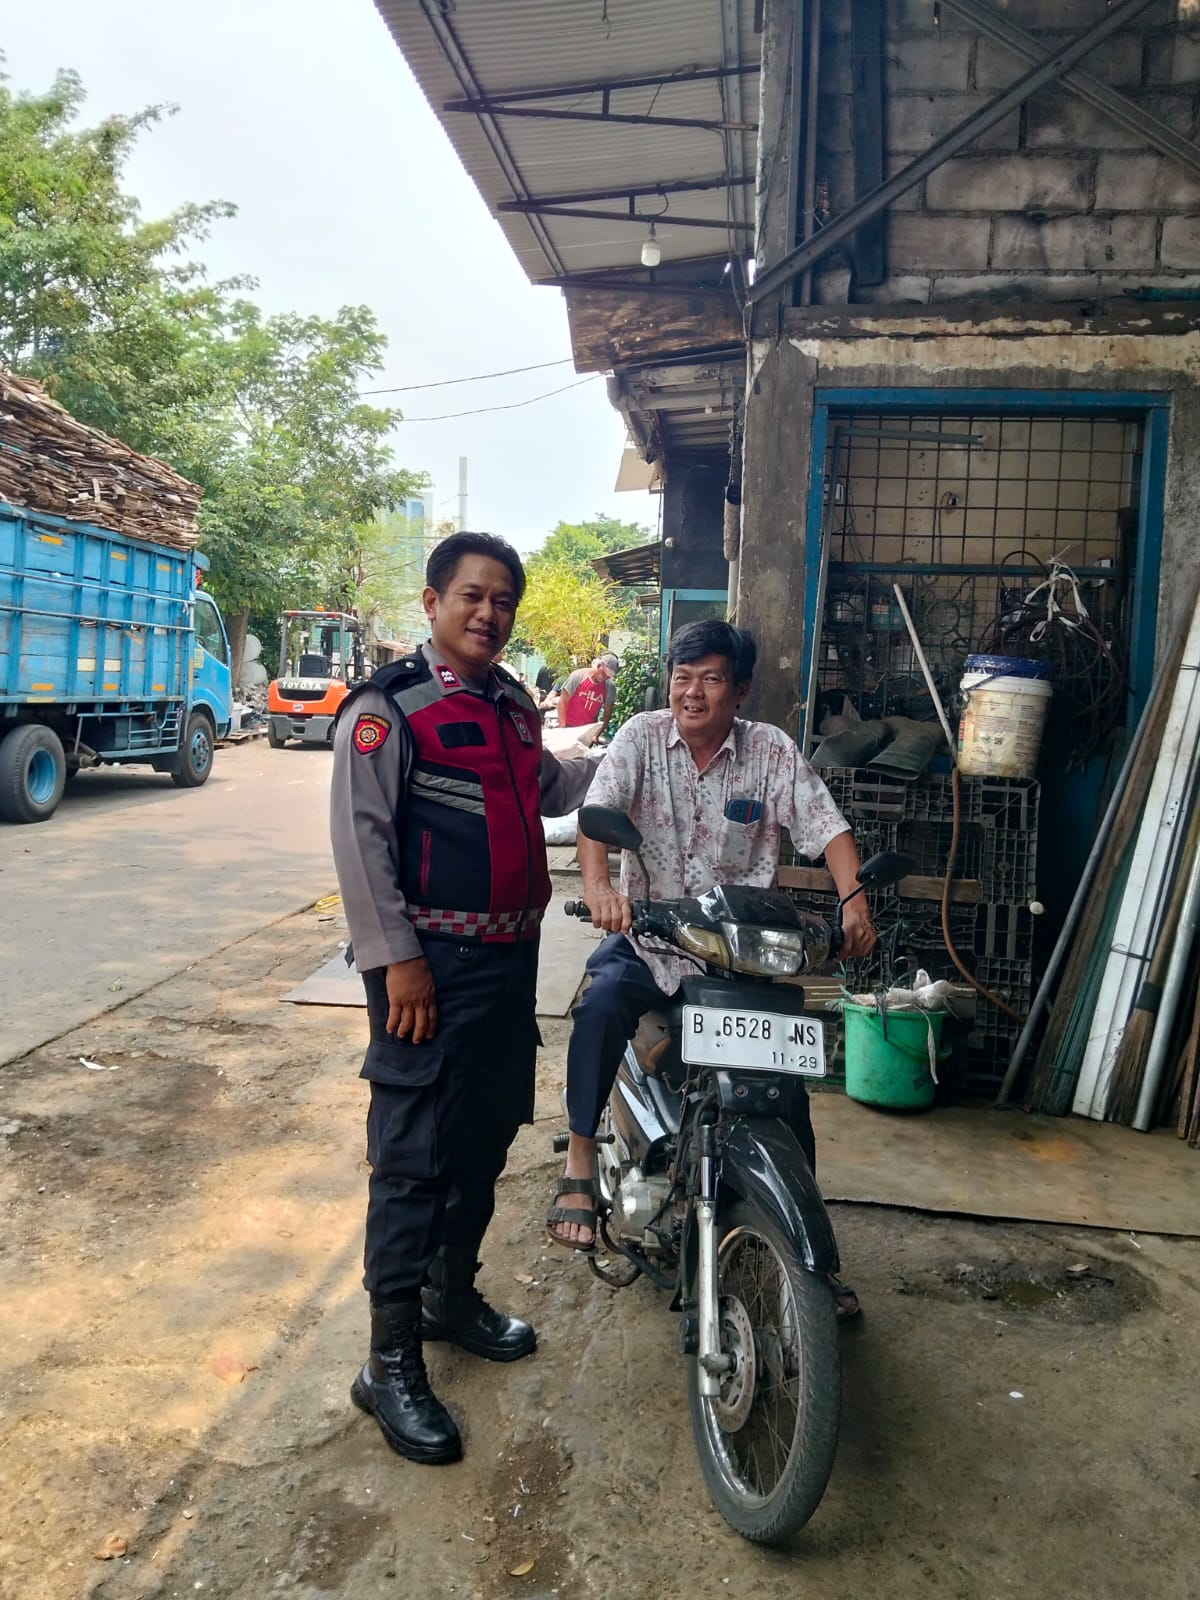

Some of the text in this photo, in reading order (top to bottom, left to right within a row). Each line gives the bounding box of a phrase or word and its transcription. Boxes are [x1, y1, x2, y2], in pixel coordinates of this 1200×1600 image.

[282, 681, 321, 690] TOYOTA
[693, 1013, 816, 1046] B 6528 NS
